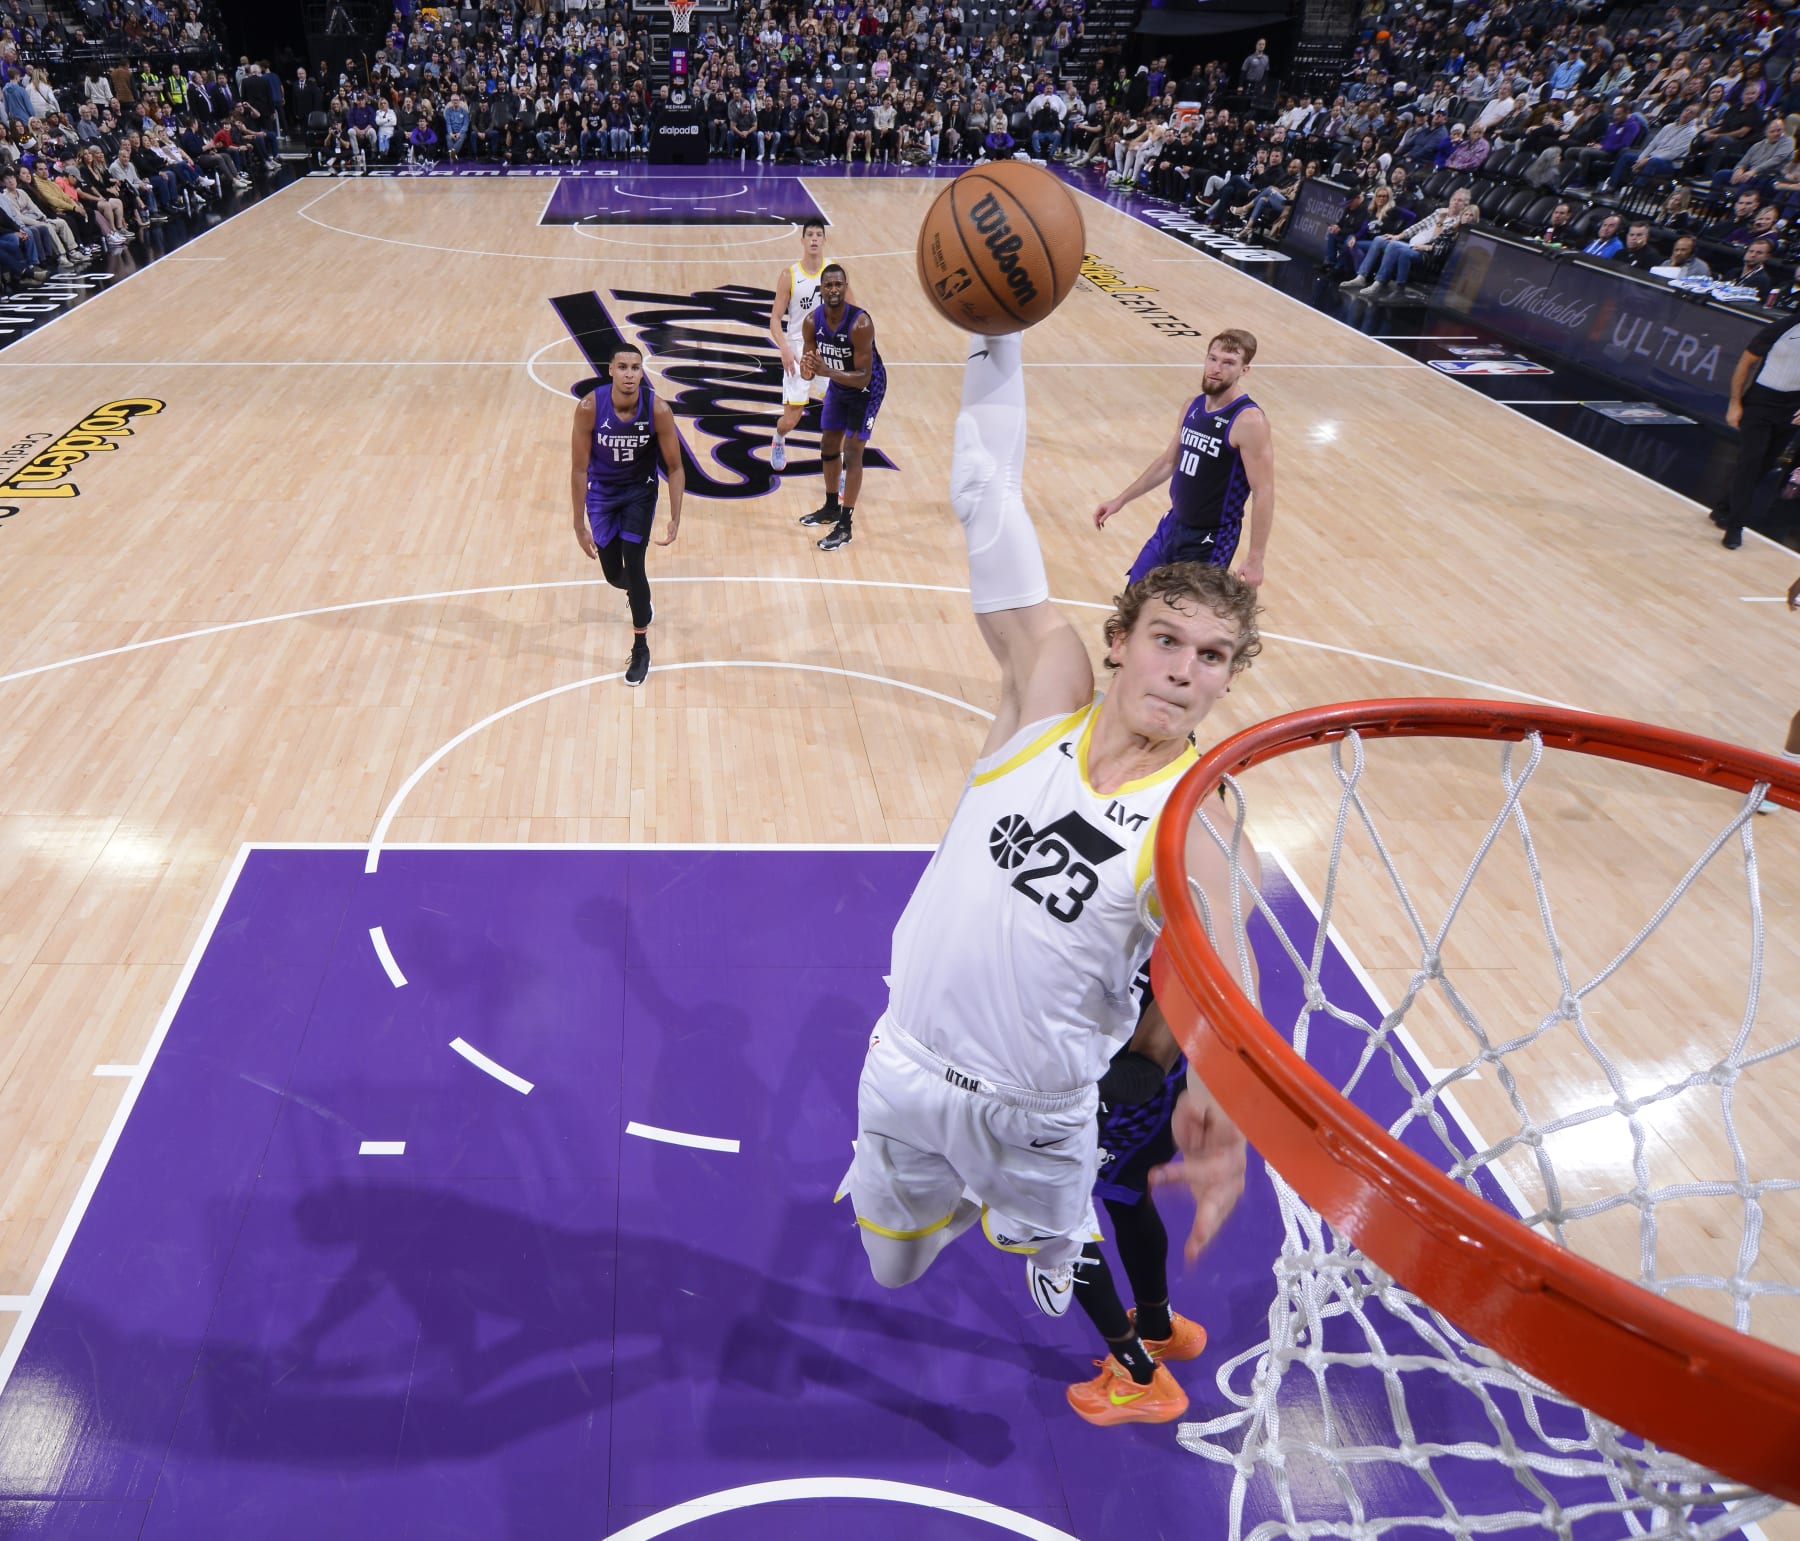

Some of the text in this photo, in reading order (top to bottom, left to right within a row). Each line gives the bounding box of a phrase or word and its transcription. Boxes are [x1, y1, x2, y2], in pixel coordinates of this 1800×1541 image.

[659, 125, 691, 136] dialpad
[1294, 215, 1321, 236] LIGHT
[969, 191, 1038, 307] Wilson
[1110, 293, 1202, 337] CENTER
[1499, 277, 1723, 382] Michelob ULTRA
[823, 356, 845, 371] 40
[612, 448, 635, 462] 13
[1180, 449, 1200, 477] 10
[1010, 838, 1100, 924] 23
[945, 1067, 980, 1092] UTAH
